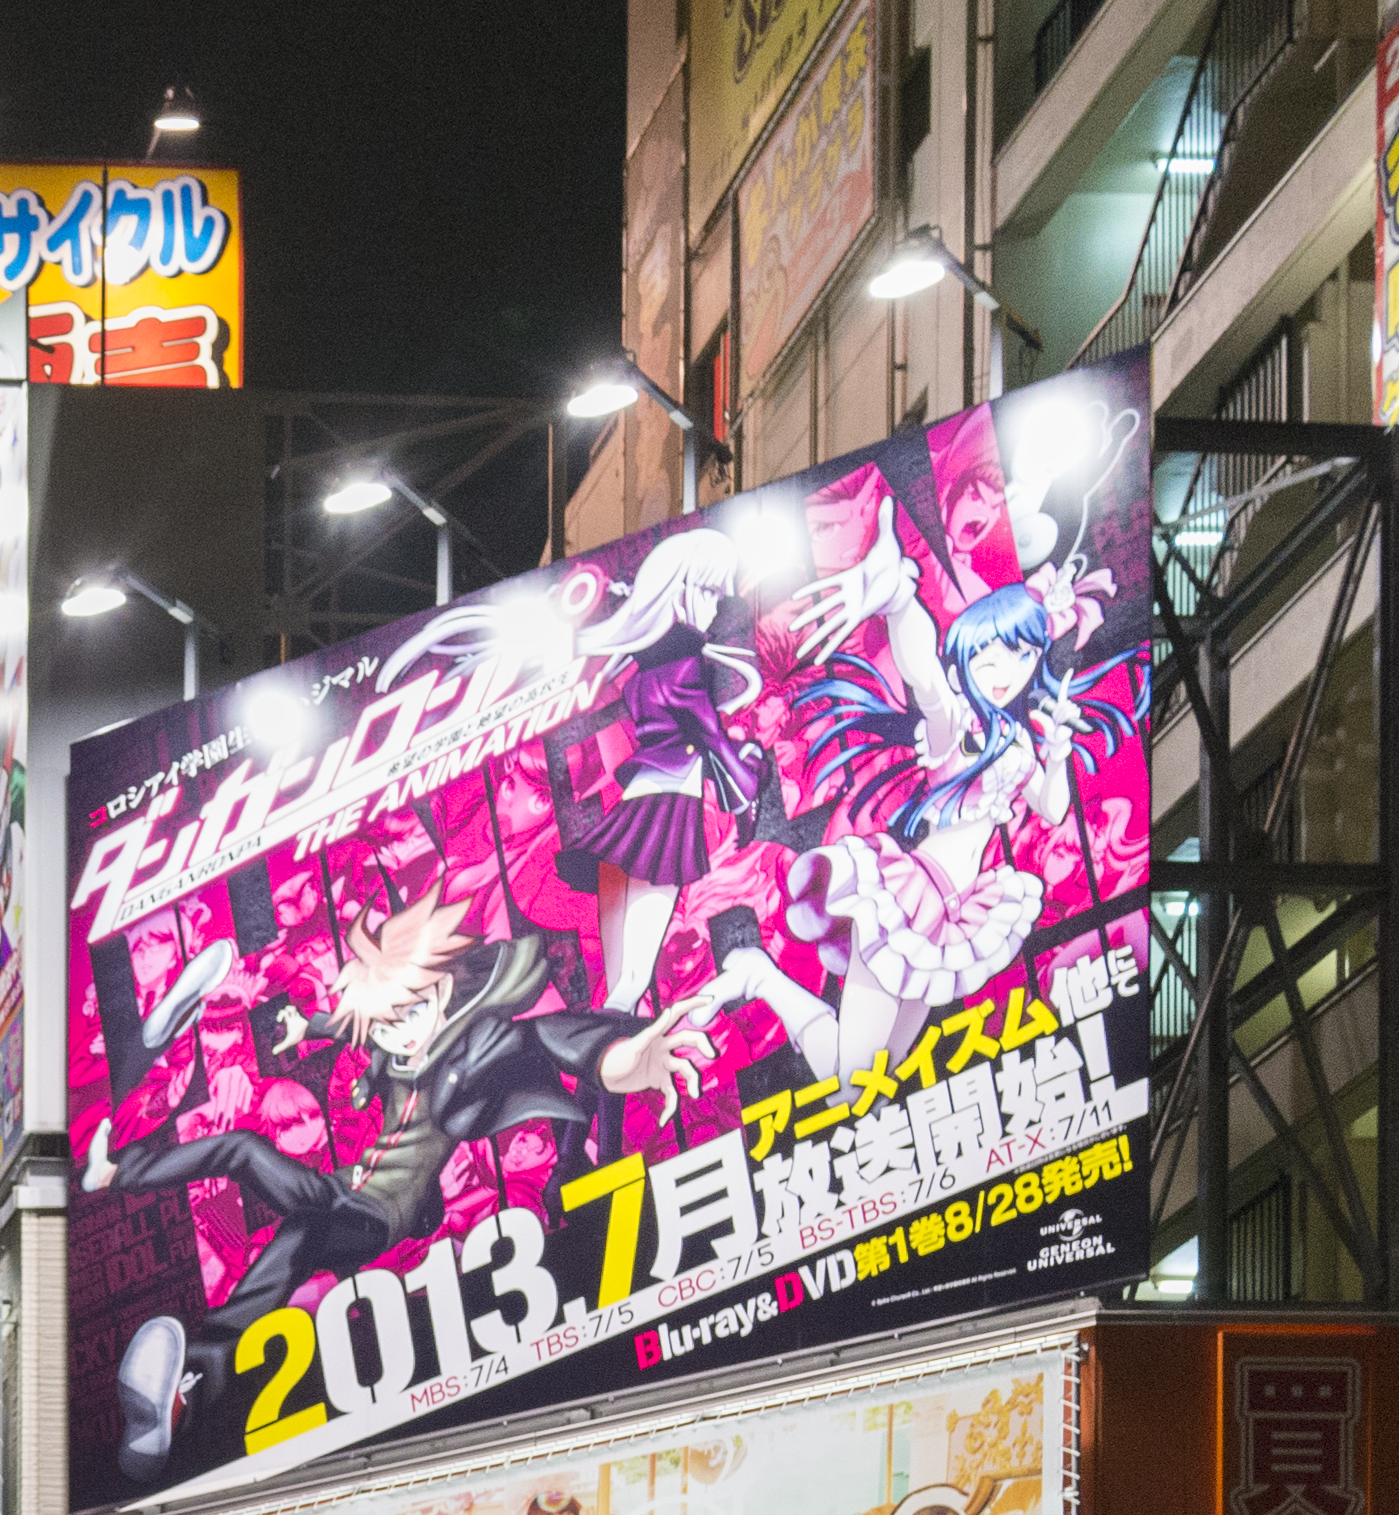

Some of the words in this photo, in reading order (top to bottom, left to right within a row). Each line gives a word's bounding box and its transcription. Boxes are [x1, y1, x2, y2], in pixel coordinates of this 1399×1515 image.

[294, 797, 368, 861] THE
[368, 673, 604, 824] ANIMATION
[1039, 1213, 1103, 1237] UNIVERSAL
[1027, 1244, 1117, 1272] UNIVERSAL
[1038, 1235, 1103, 1258] GENEON
